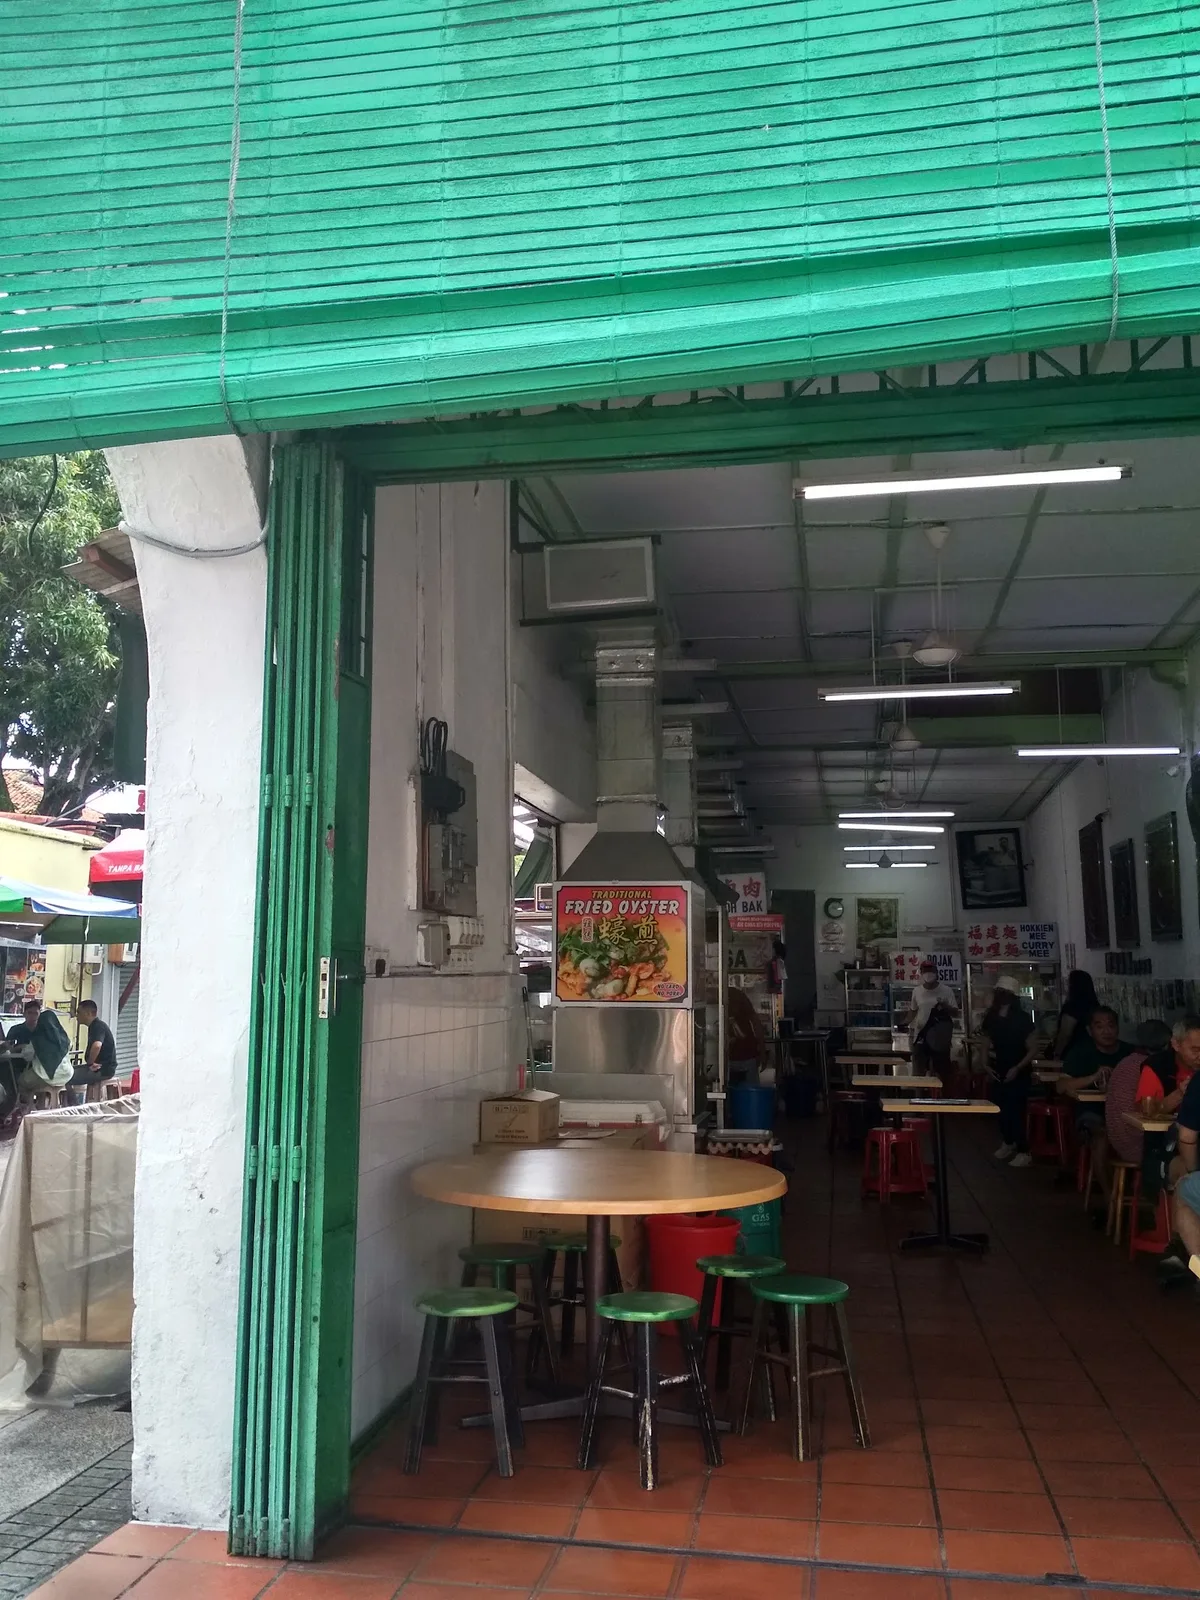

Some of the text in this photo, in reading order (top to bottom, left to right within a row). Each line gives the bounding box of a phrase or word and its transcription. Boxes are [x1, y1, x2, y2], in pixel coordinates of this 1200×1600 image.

[592, 890, 652, 899] TRADITIONAL
[565, 900, 680, 915] FRIED OYSTER
[742, 900, 763, 913] BAK
[1020, 924, 1054, 932] HOKKIEN
[1022, 941, 1055, 950] CURRY
[752, 1213, 770, 1222] GAS
